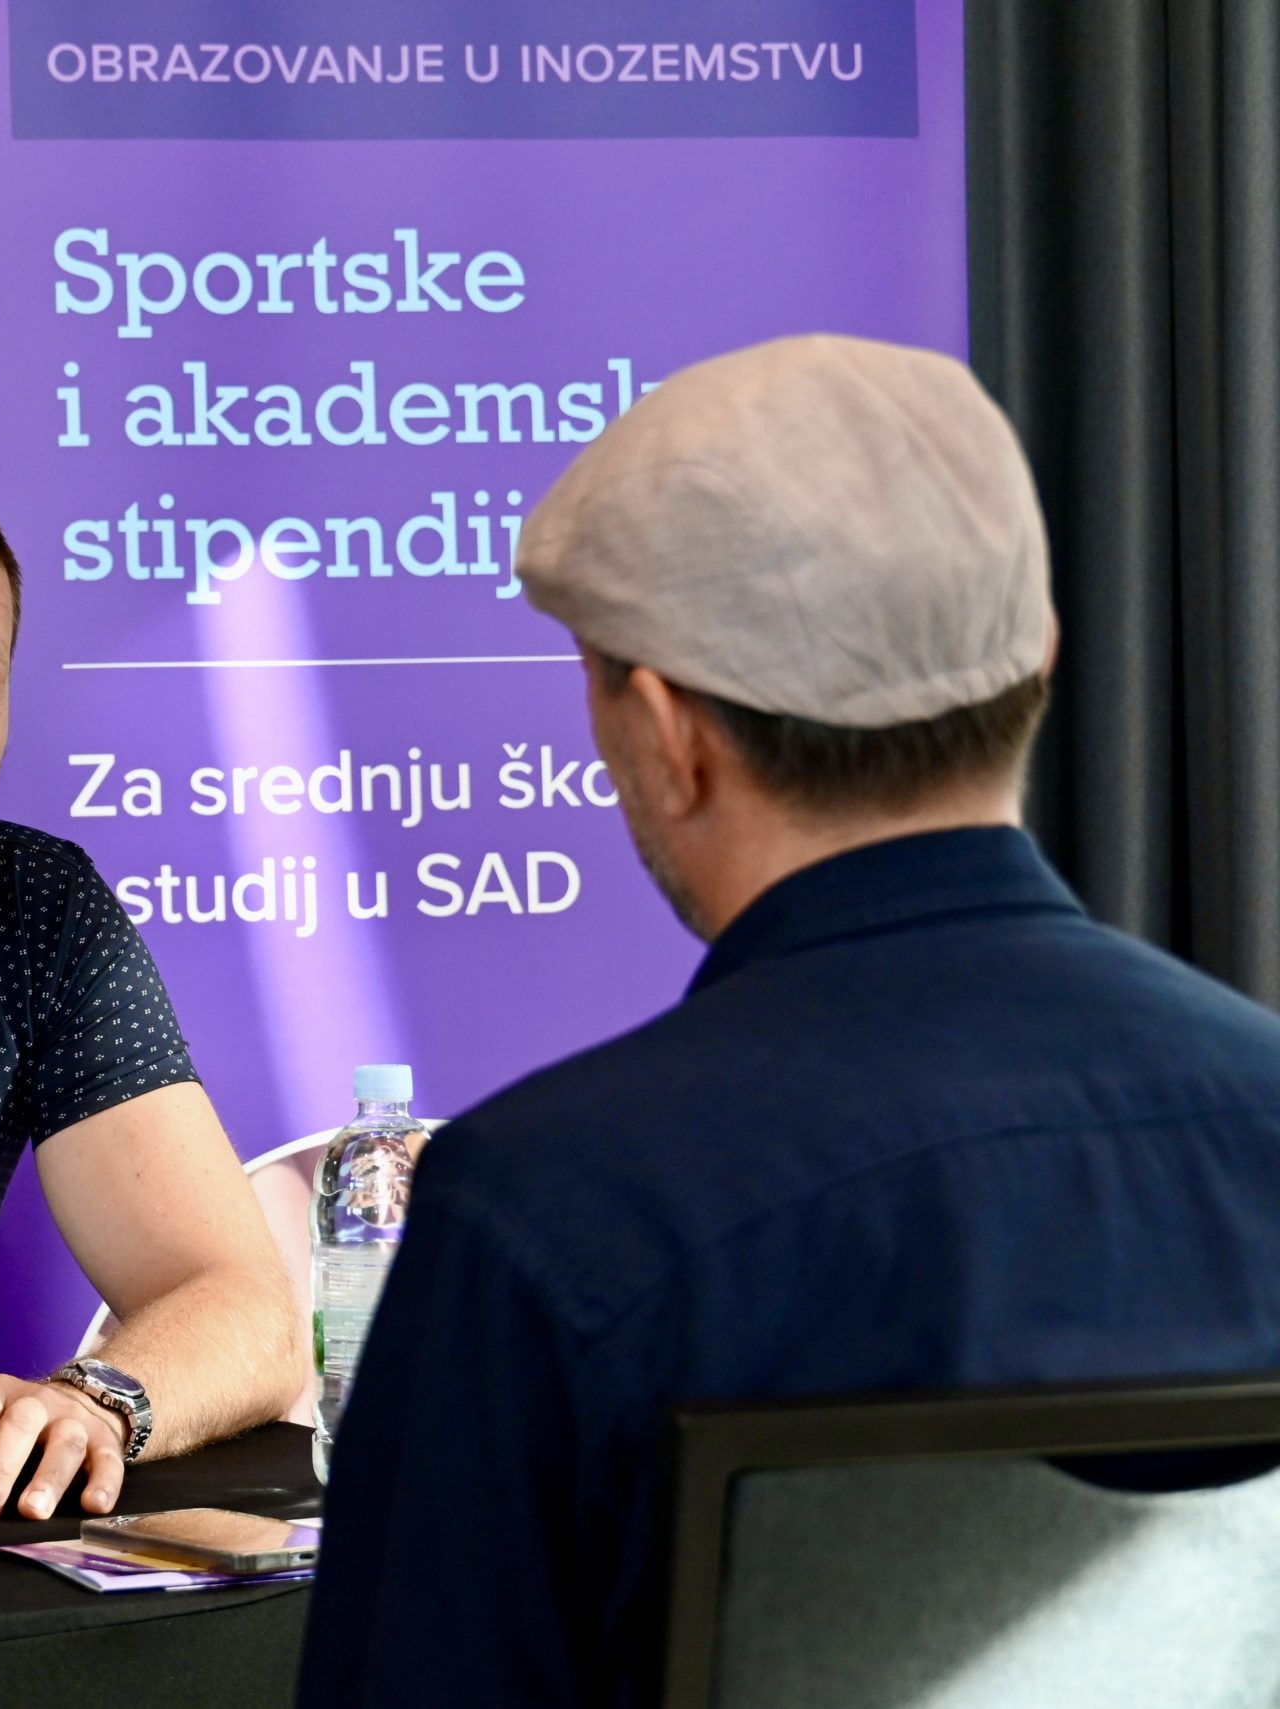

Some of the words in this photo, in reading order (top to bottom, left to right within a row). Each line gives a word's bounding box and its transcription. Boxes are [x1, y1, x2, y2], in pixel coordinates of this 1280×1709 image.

[47, 43, 444, 83] OBRAZOVANJE
[465, 44, 498, 83] U
[521, 42, 862, 83] INOZEMSTVU
[53, 227, 525, 339] Sportske
[56, 361, 90, 447] i
[68, 753, 162, 817] Za
[190, 747, 471, 828] srednju
[116, 855, 318, 938] studij
[346, 871, 388, 920] u
[416, 851, 581, 918] SAD
